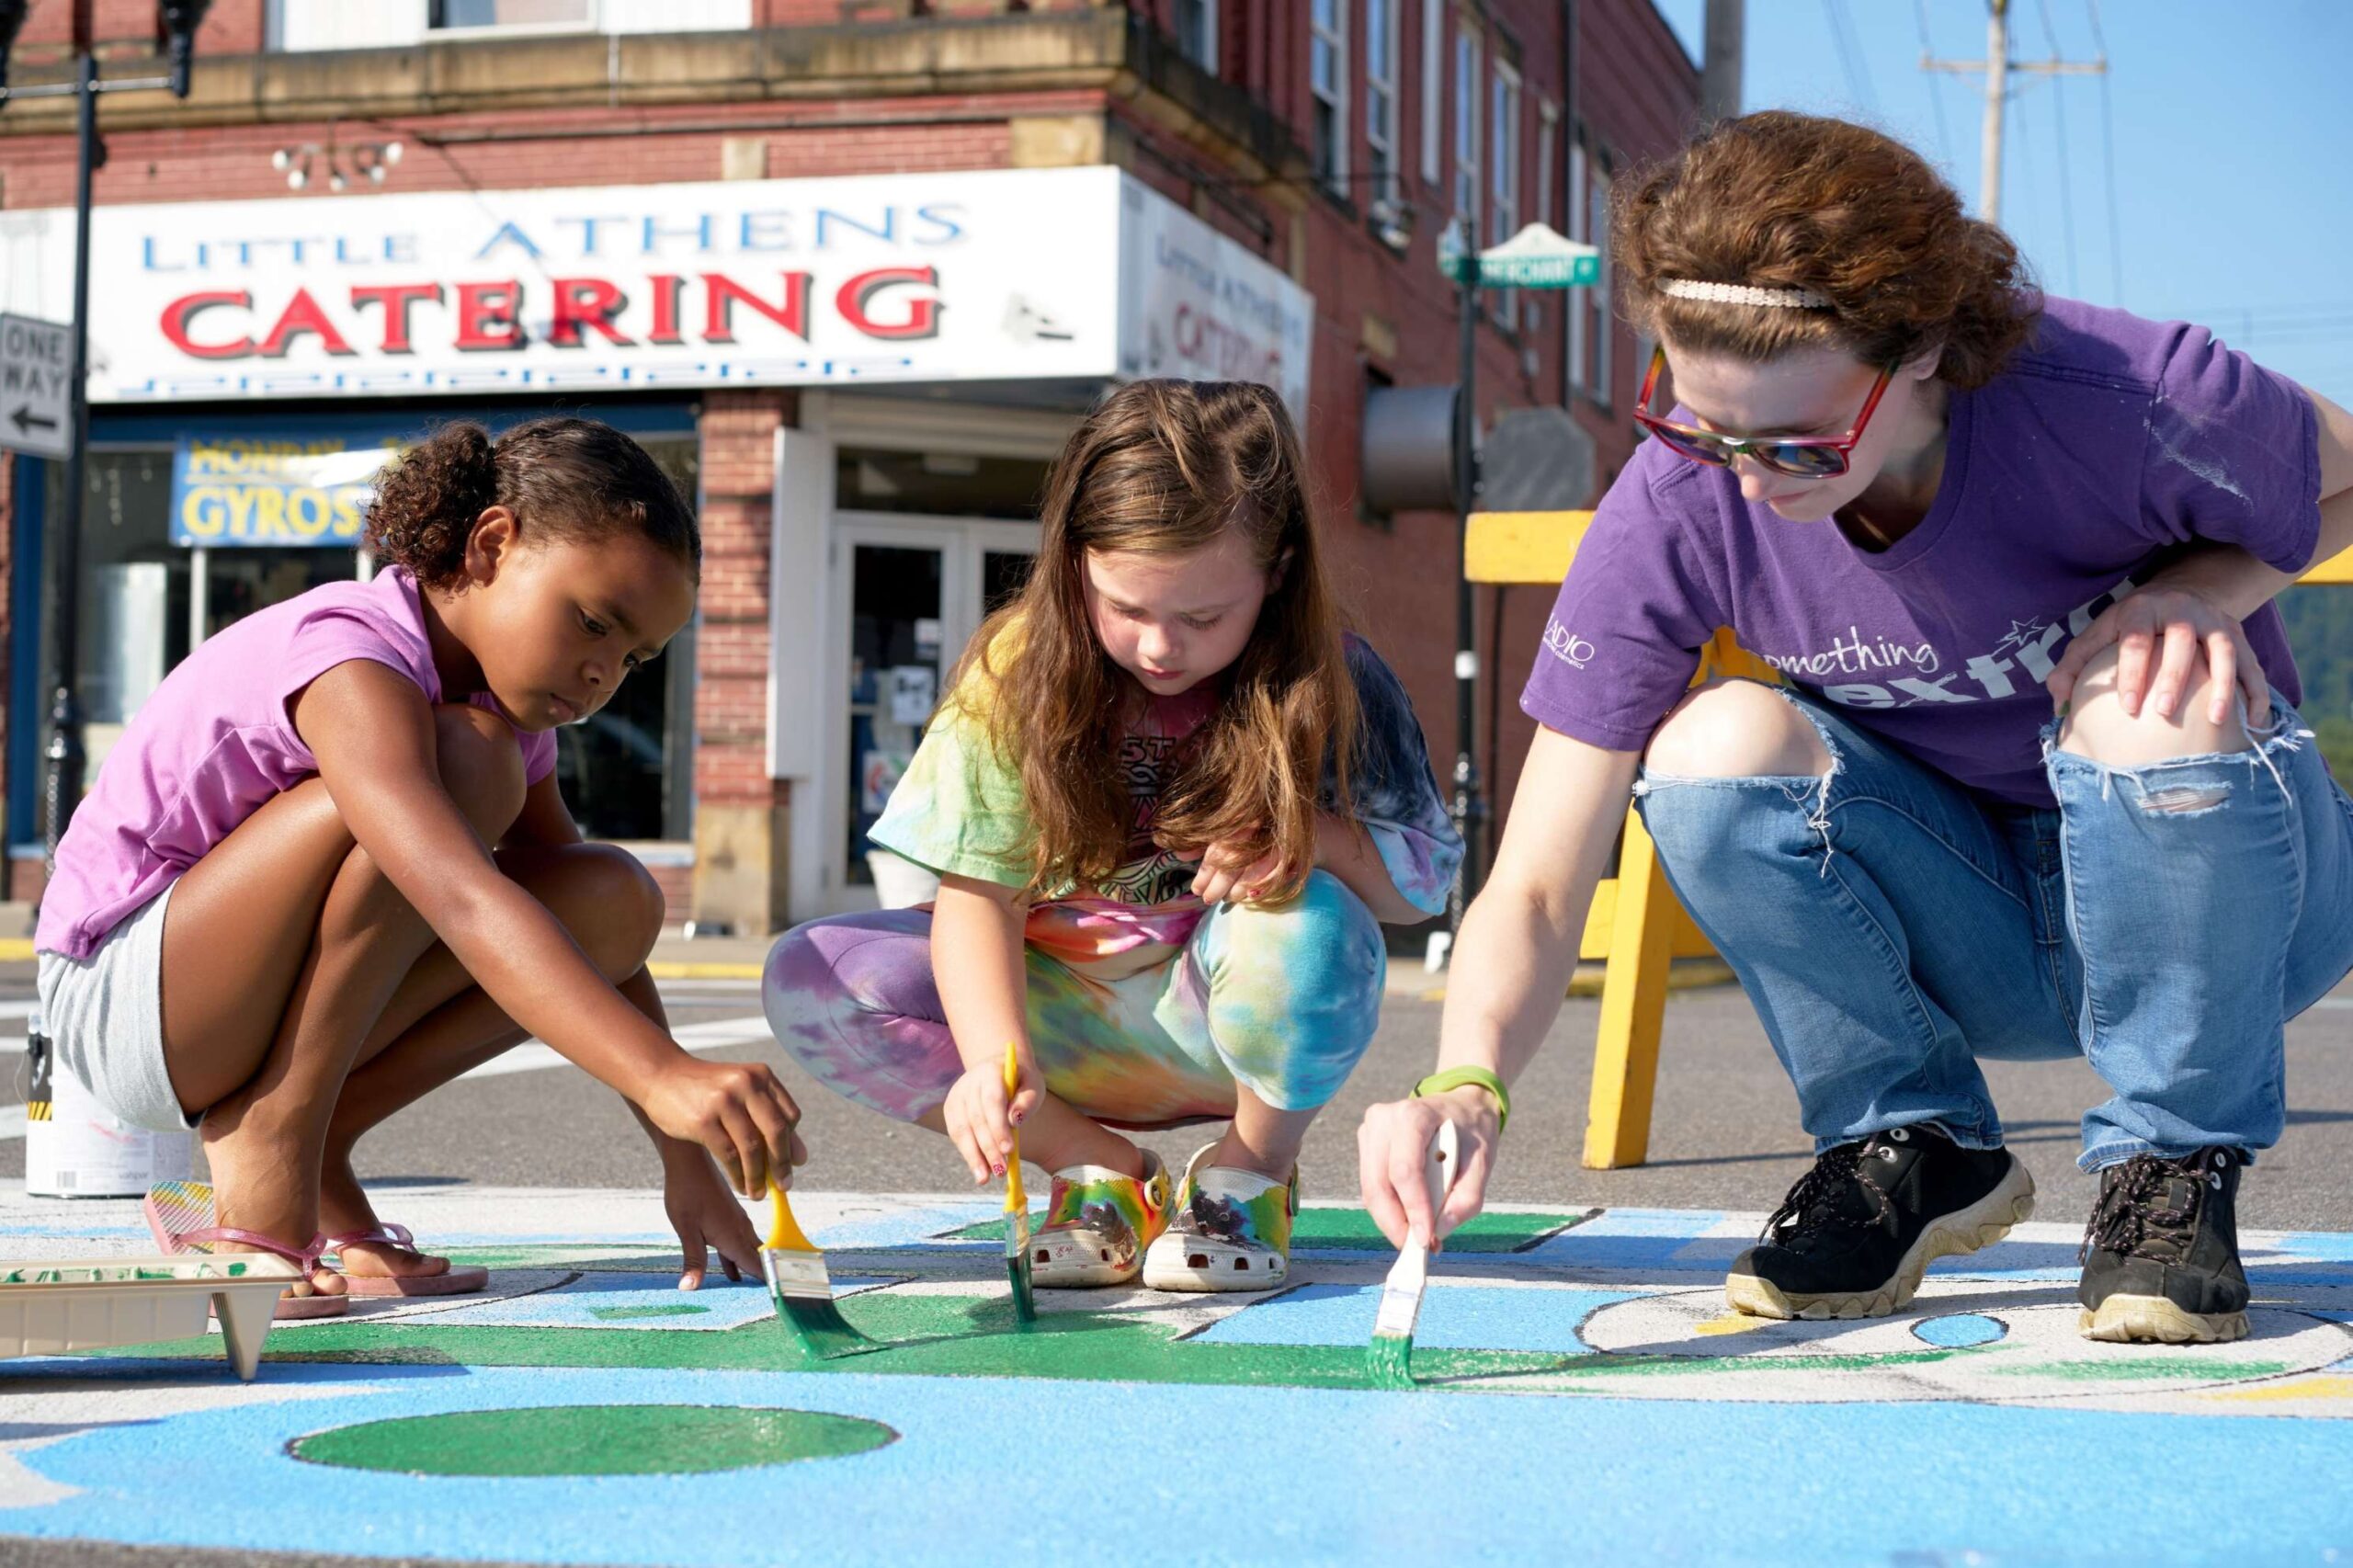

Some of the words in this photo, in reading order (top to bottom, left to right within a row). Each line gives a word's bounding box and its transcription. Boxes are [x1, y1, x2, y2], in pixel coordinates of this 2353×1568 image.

[142, 233, 420, 270] LITTLE
[473, 200, 968, 258] ATHENS
[159, 265, 946, 358] CATERING
[6, 324, 64, 366] ONE
[5, 363, 63, 400] WAY
[182, 486, 364, 537] GYROS
[1763, 625, 1939, 676] omething
